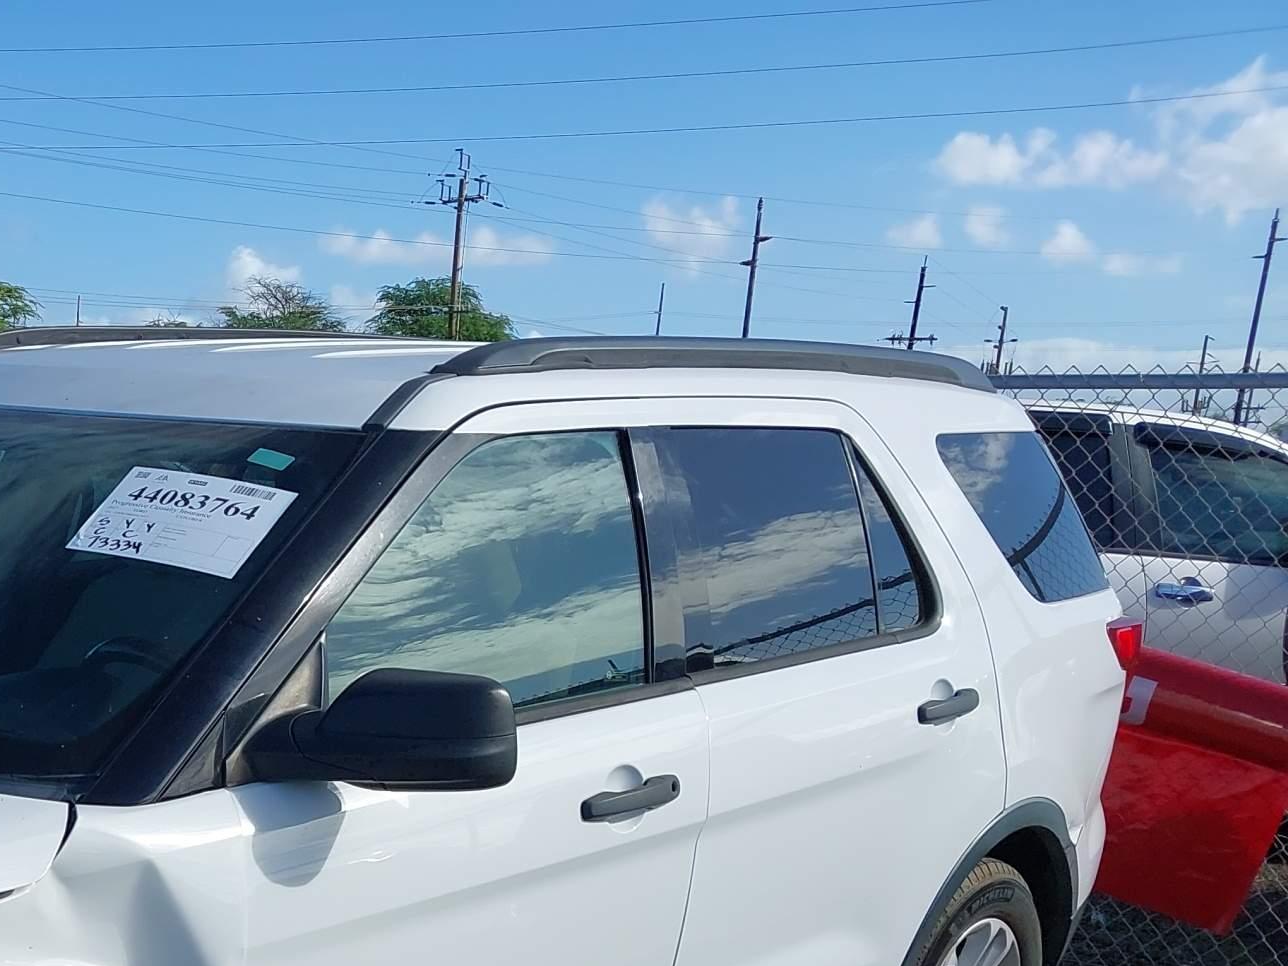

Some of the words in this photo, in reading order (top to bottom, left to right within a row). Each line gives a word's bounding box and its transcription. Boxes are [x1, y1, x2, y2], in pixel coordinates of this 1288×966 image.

[127, 486, 261, 521] 44083764
[125, 518, 135, 528] Y
[146, 522, 156, 533] Y
